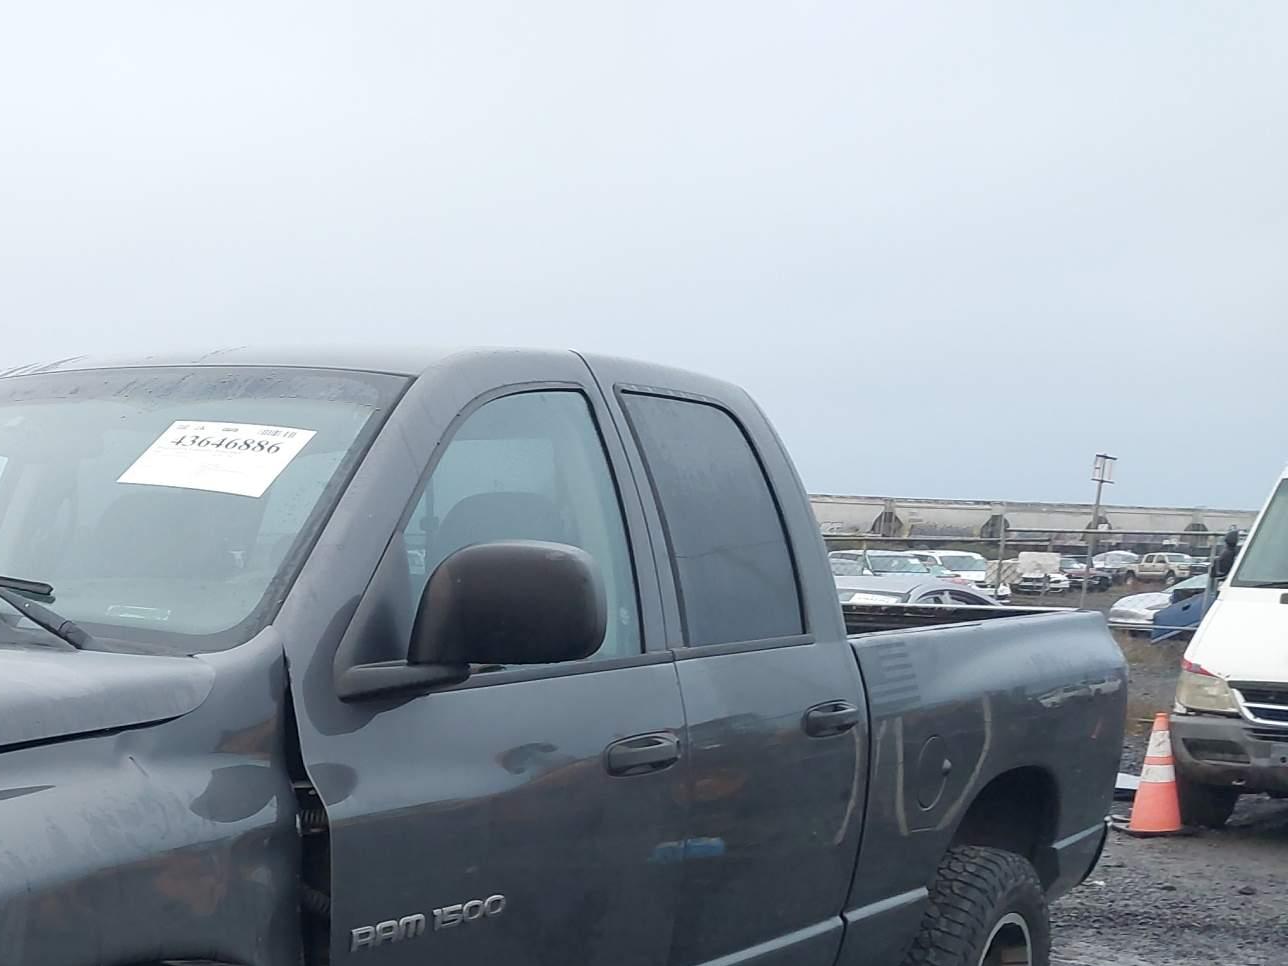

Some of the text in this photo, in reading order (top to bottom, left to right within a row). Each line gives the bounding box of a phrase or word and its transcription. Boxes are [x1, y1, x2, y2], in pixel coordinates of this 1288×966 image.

[170, 434, 283, 455] 43646886
[350, 894, 506, 952] RAM 1500
